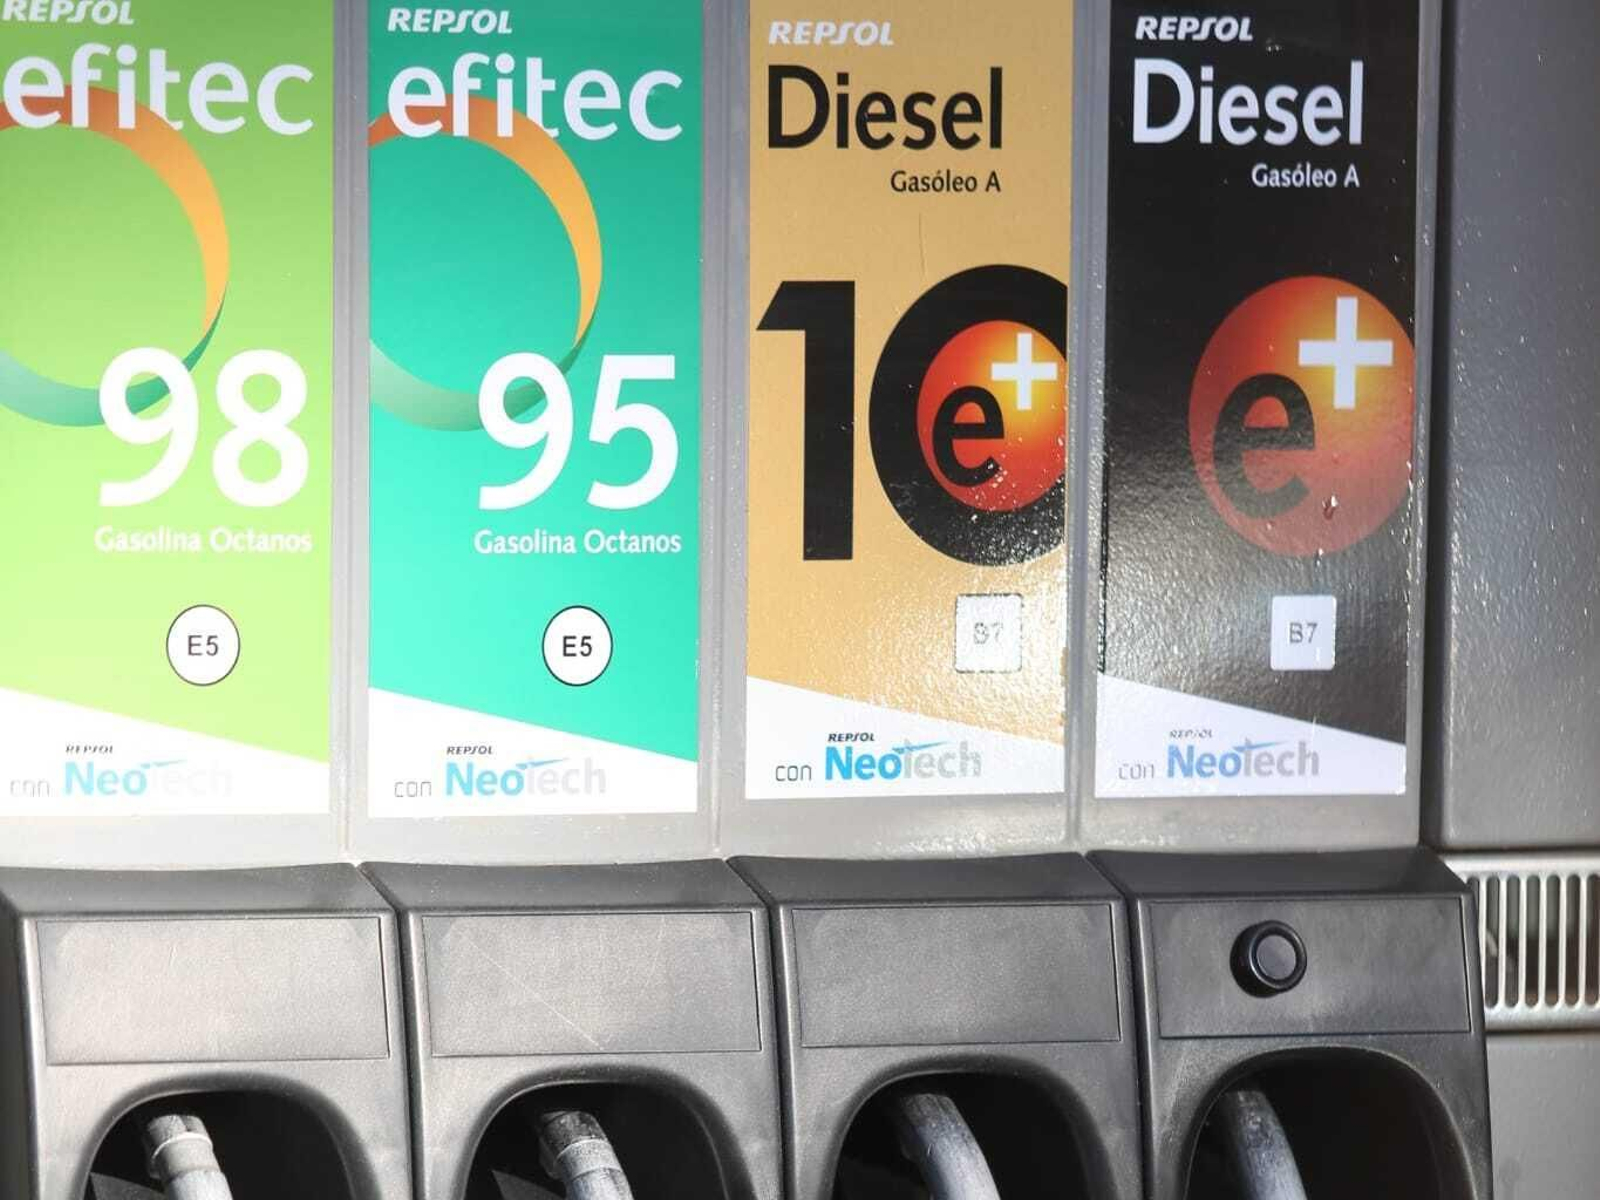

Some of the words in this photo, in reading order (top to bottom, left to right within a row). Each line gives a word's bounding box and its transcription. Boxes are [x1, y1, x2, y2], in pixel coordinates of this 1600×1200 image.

[2, 0, 135, 25] REPSOL
[387, 8, 513, 35] REPSOL
[768, 20, 894, 47] REPSOL
[1135, 16, 1253, 42] REPSOL
[2, 43, 314, 136] efitec
[387, 52, 683, 141] efitec
[1132, 57, 1364, 146] Diesel
[767, 64, 1003, 151] Diesel
[890, 170, 977, 194] Gasóleo
[984, 172, 1001, 193] A
[1251, 163, 1337, 189] Gasóleo
[1343, 164, 1360, 188] A
[99, 347, 309, 508] 98
[478, 352, 680, 511] 95
[94, 527, 202, 554] Gasolina
[209, 527, 312, 554] Octanos
[474, 529, 577, 555] Gasolina
[583, 530, 682, 555] Octanos
[187, 634, 219, 657] E5
[1289, 622, 1318, 644] B7
[563, 635, 593, 658] E5
[446, 745, 494, 756] REPSOL
[828, 732, 876, 743] REPSOL
[775, 765, 812, 782] con
[394, 781, 432, 798] con
